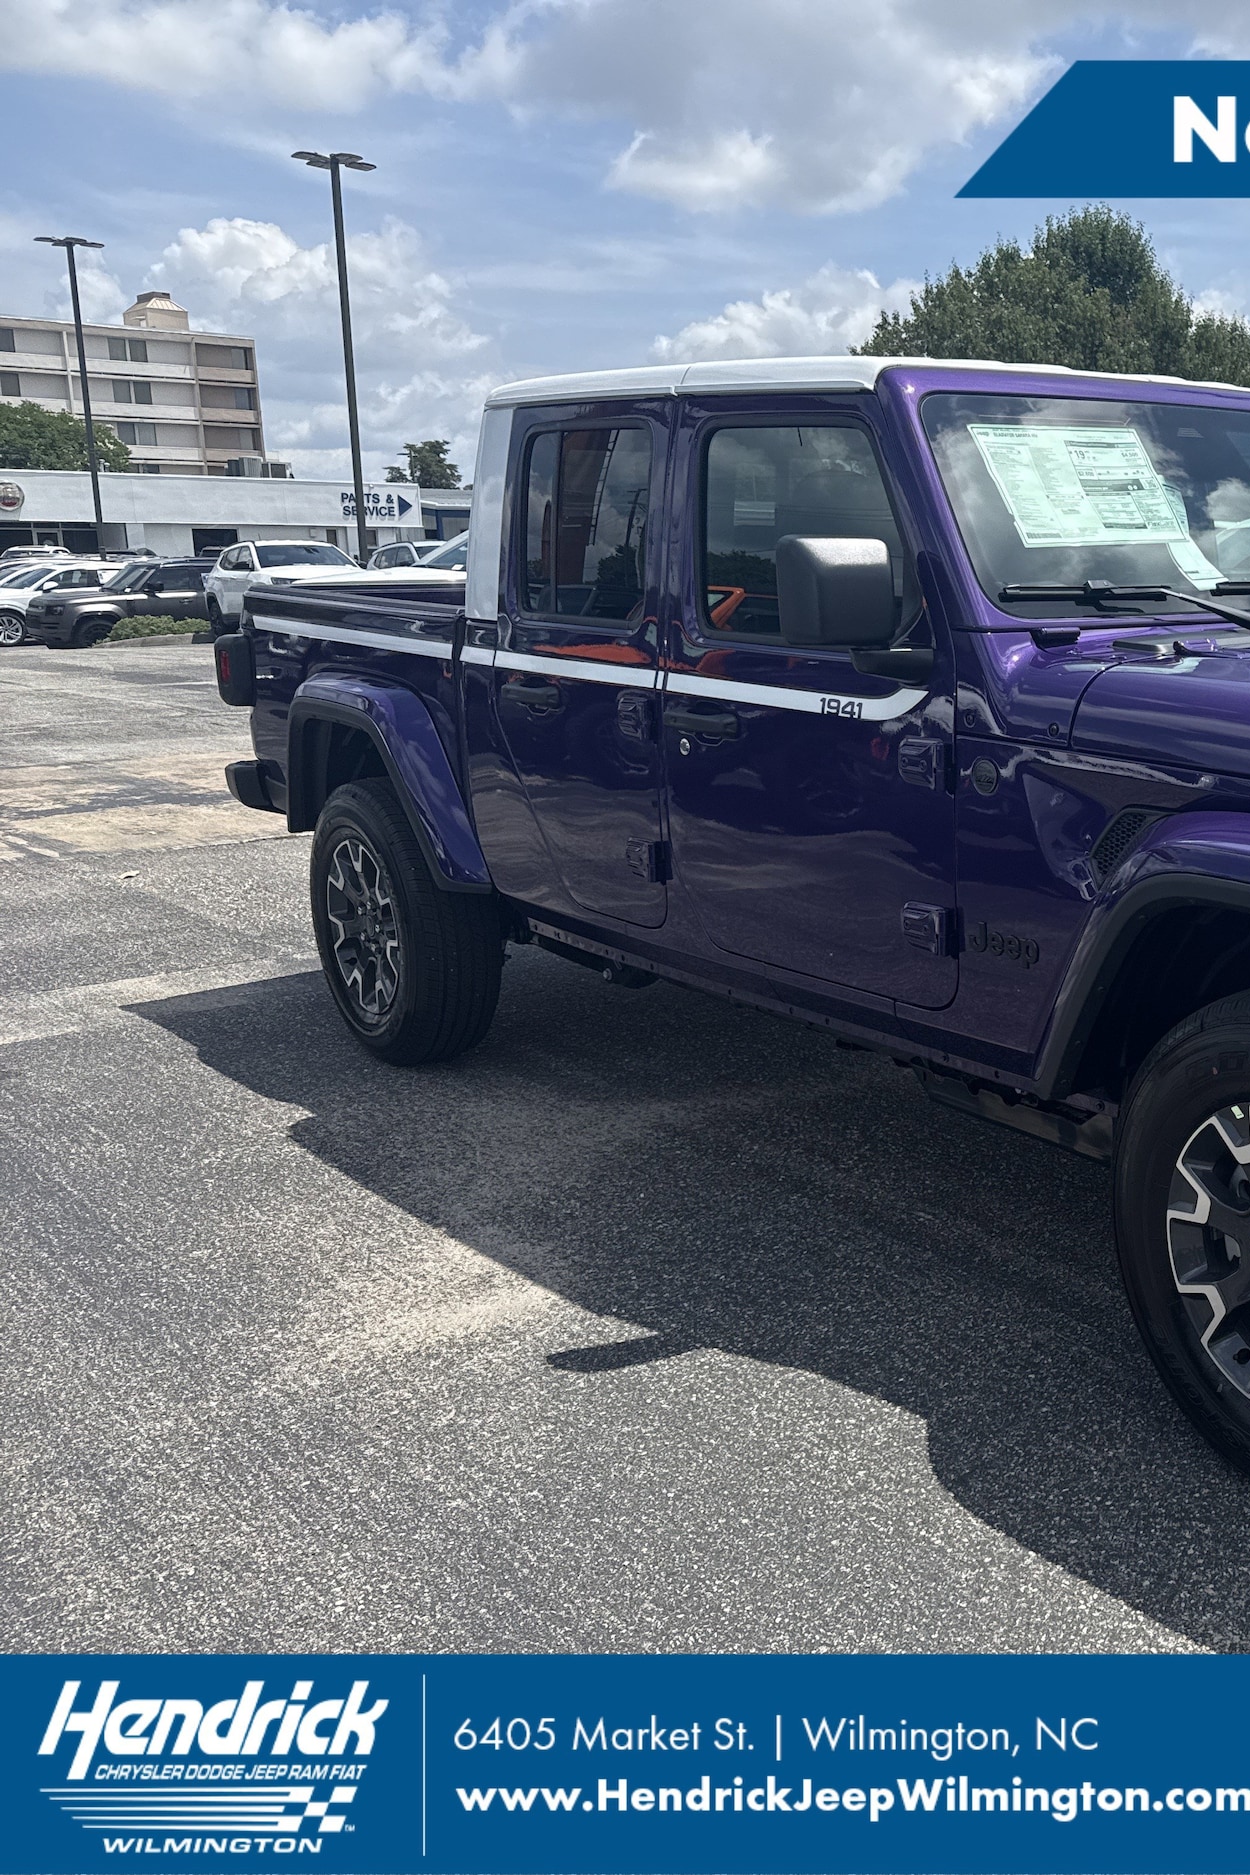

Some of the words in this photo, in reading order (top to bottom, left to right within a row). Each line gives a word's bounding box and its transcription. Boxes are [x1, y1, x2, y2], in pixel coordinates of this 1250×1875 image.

[341, 493, 379, 503] PATS
[386, 494, 394, 503] &
[820, 698, 863, 719] 1941
[968, 921, 1040, 969] Jeep
